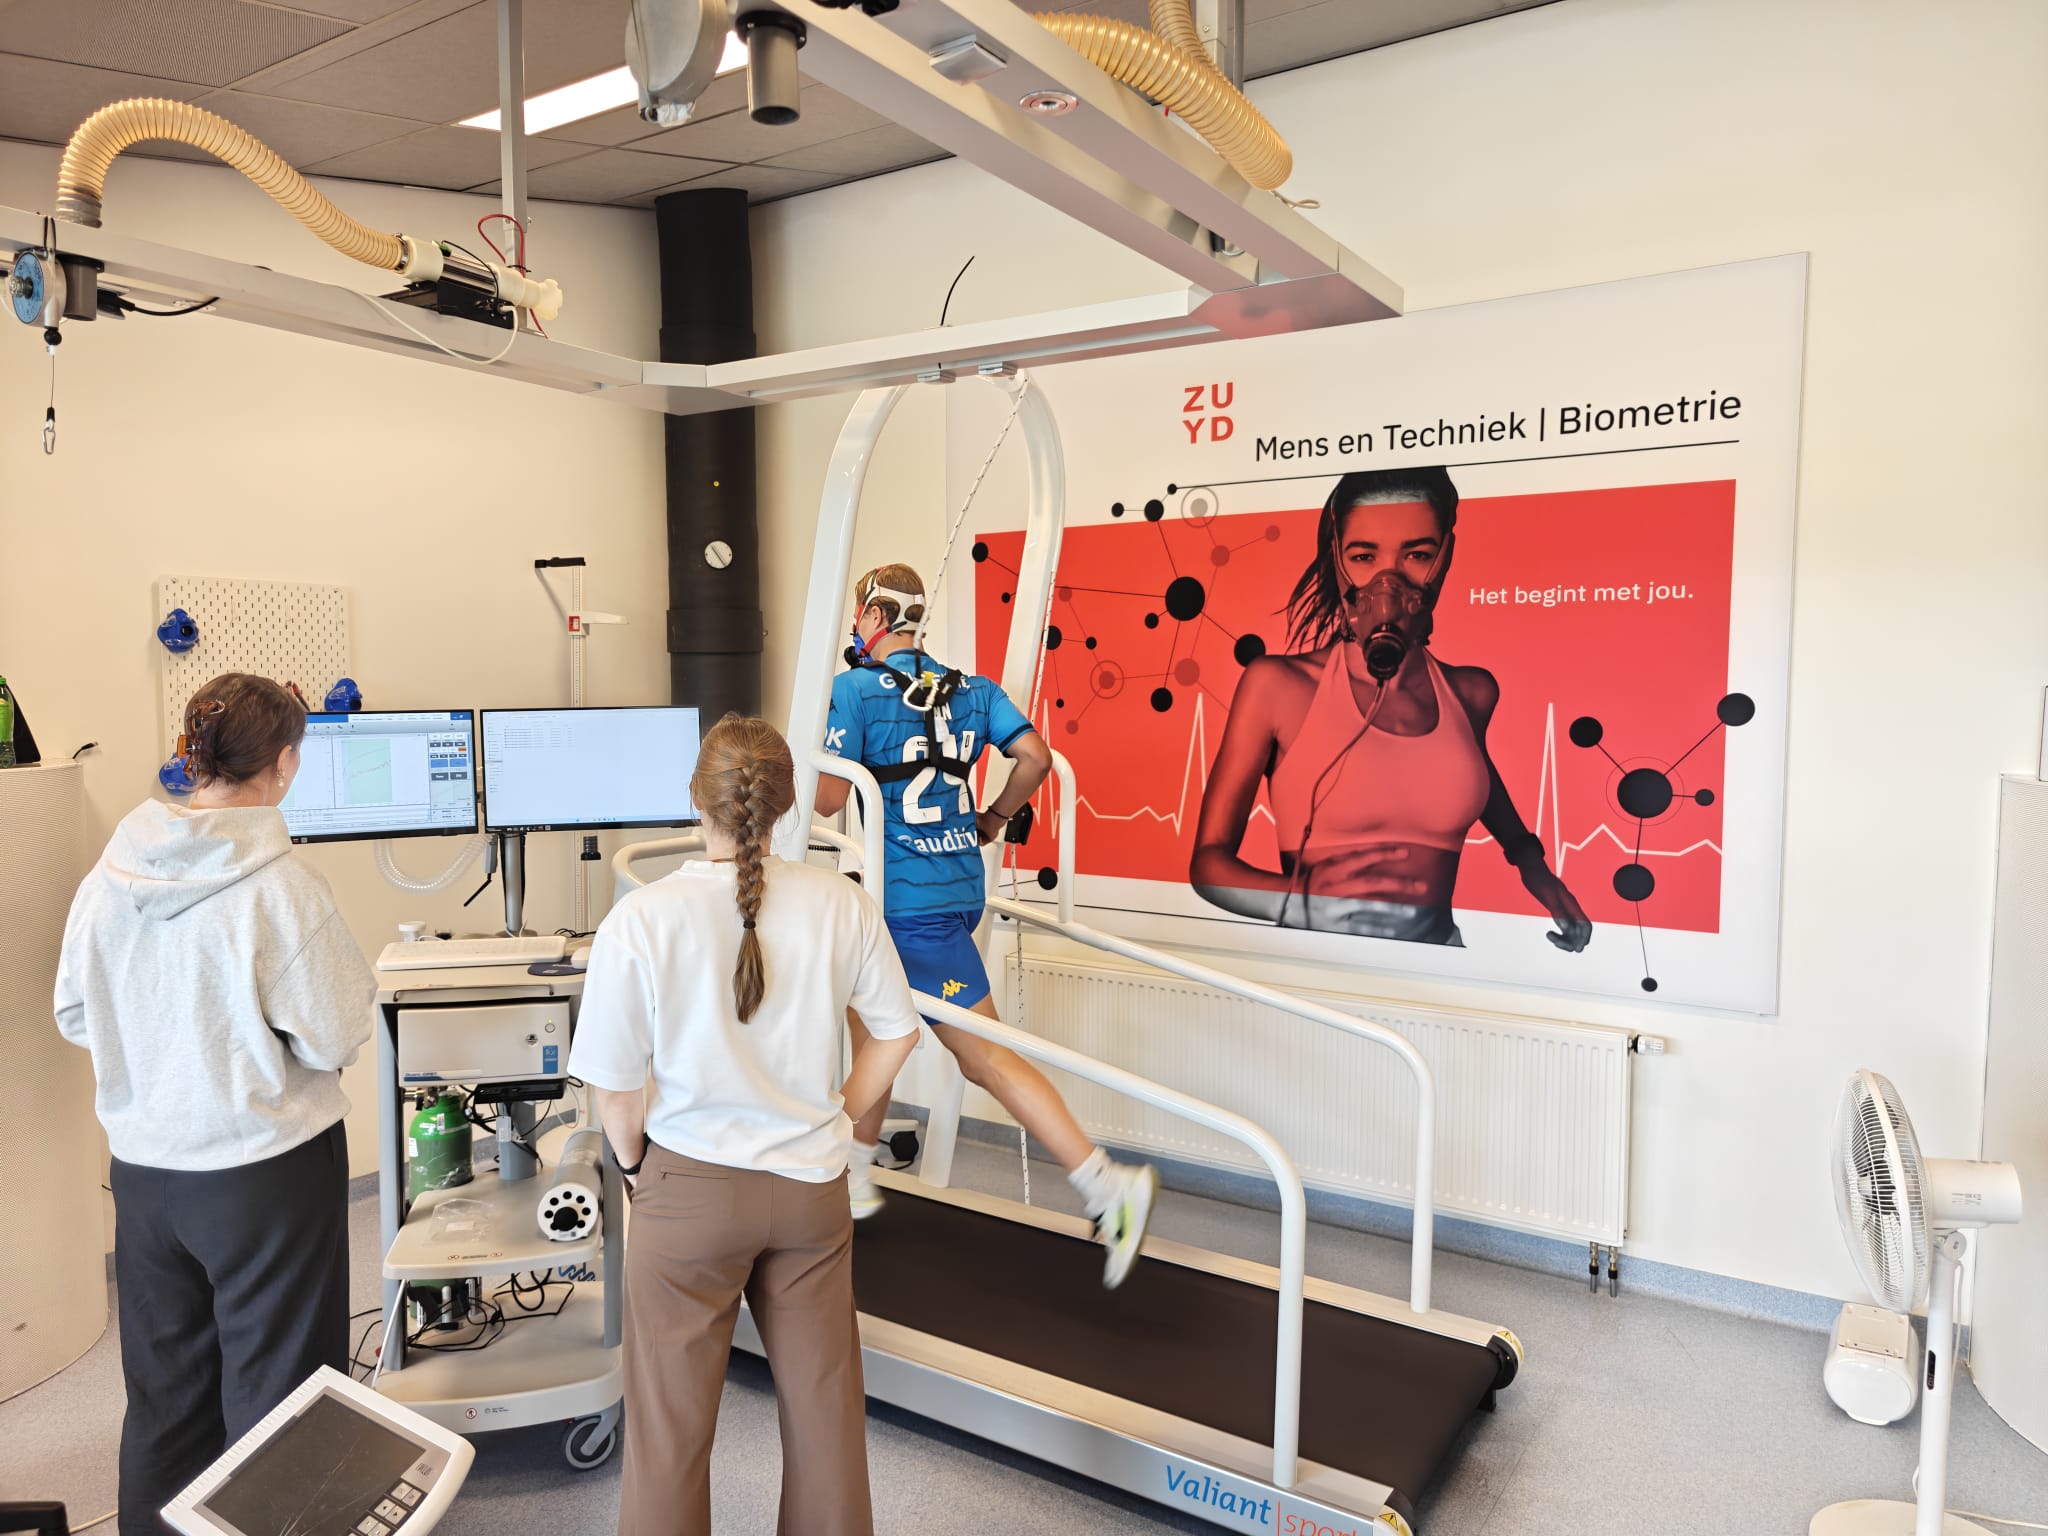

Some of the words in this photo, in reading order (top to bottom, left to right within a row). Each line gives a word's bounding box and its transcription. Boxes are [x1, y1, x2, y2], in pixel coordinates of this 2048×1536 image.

[1182, 380, 1235, 414] ZU
[1182, 414, 1236, 446] YD
[1255, 436, 1329, 462] Mens
[1338, 433, 1373, 455] en
[1382, 411, 1527, 451] Techniek
[1559, 389, 1742, 435] Biometrie
[1470, 587, 1508, 606] Het
[1515, 584, 1587, 609] begint
[1594, 583, 1641, 602] met
[1645, 581, 1693, 605] jou.
[1165, 1463, 1273, 1527] Valiant
[1283, 1513, 1358, 1536] spo
